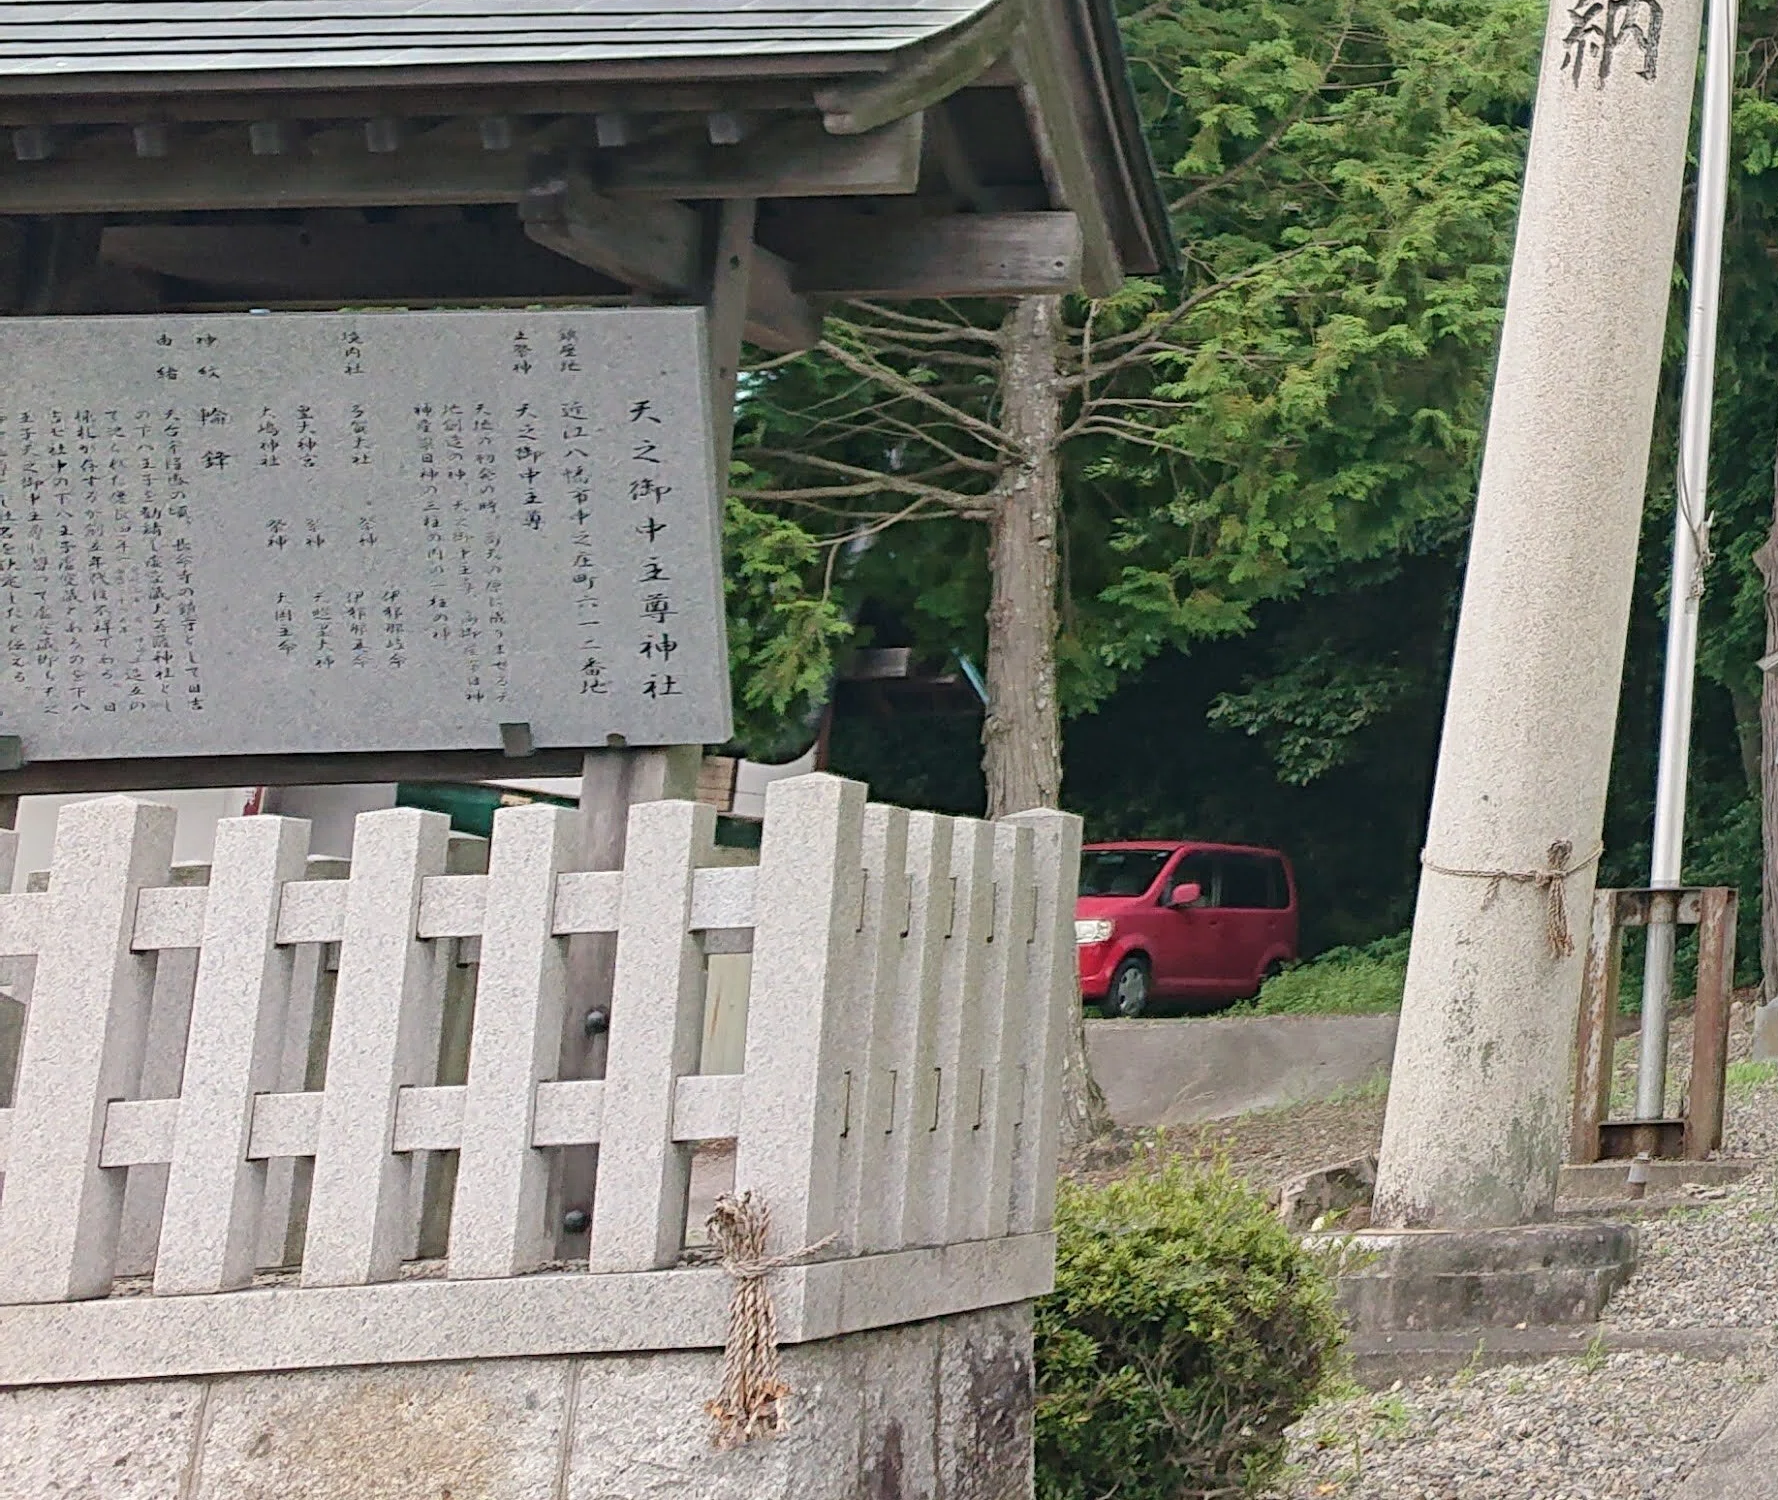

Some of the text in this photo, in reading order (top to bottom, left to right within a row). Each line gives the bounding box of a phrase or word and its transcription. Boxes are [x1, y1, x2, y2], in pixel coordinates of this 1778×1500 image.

[514, 402, 547, 532] 天之御中主尊
[629, 399, 684, 699] 天之御中主尊神社
